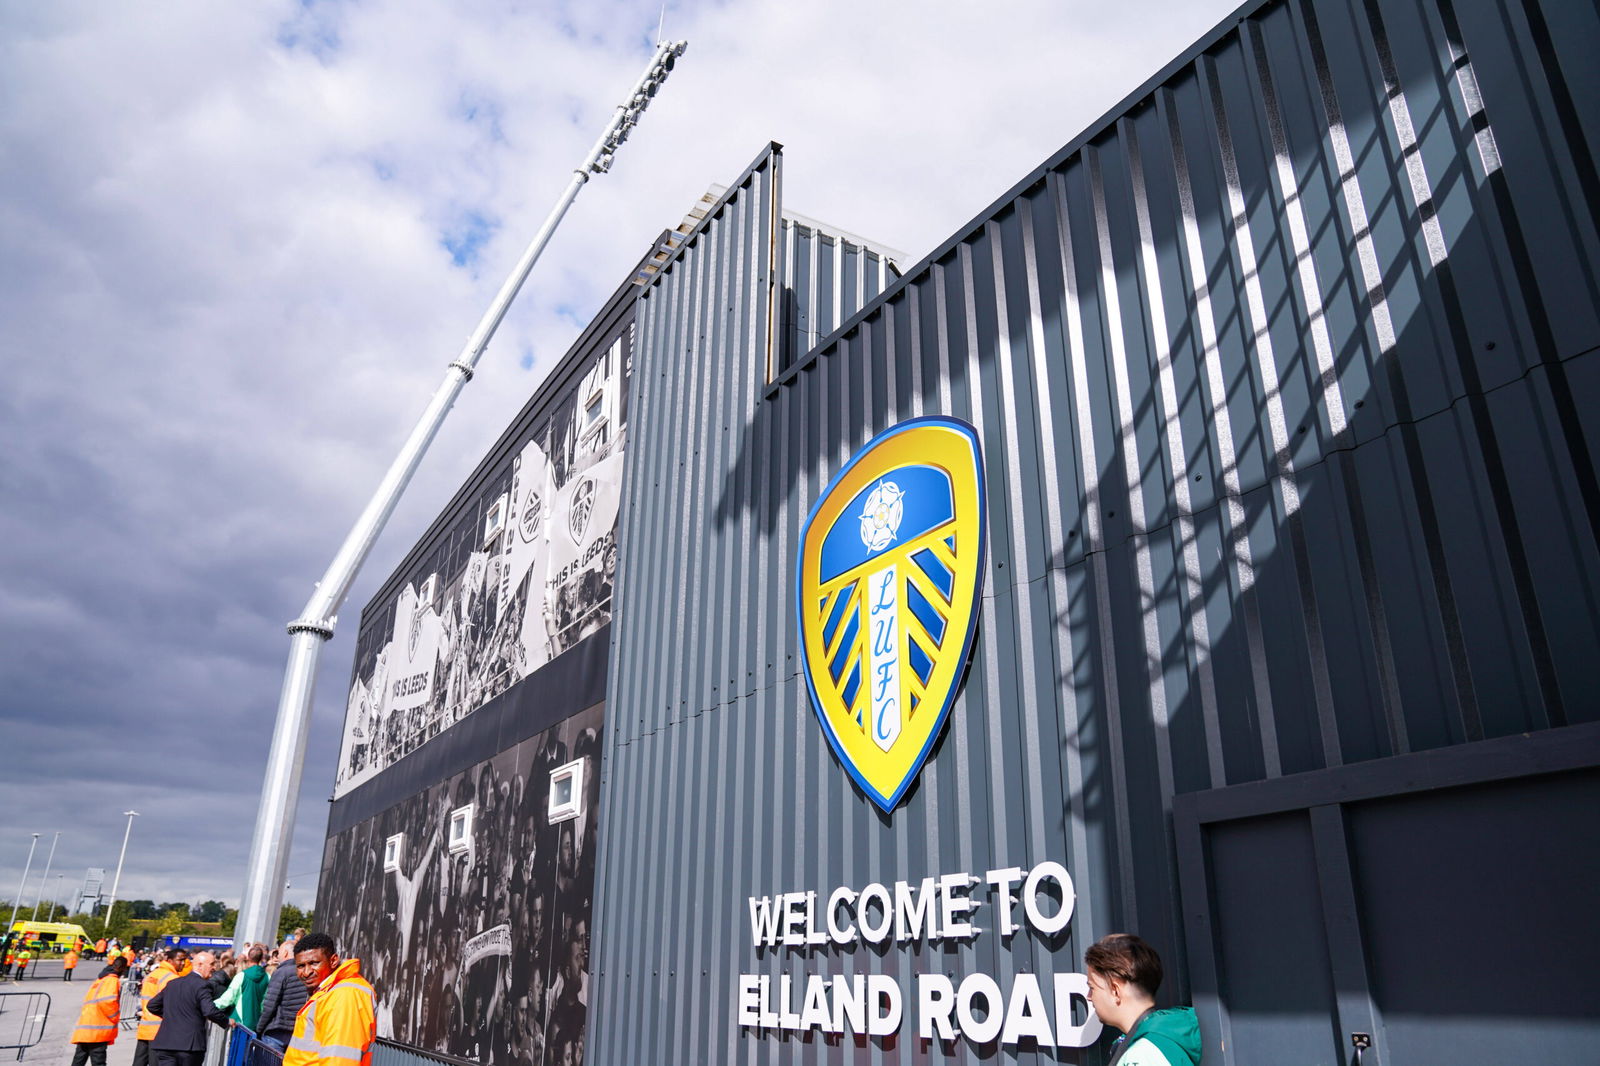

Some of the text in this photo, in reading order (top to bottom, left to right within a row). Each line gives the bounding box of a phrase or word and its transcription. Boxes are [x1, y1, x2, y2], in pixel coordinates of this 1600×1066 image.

[549, 566, 569, 590] HIS
[570, 559, 579, 576] IS
[407, 671, 429, 696] LEEDS
[870, 569, 897, 741] LUFC
[748, 860, 1076, 947] WELCOME TO
[738, 972, 1102, 1048] ELLAND ROAD
